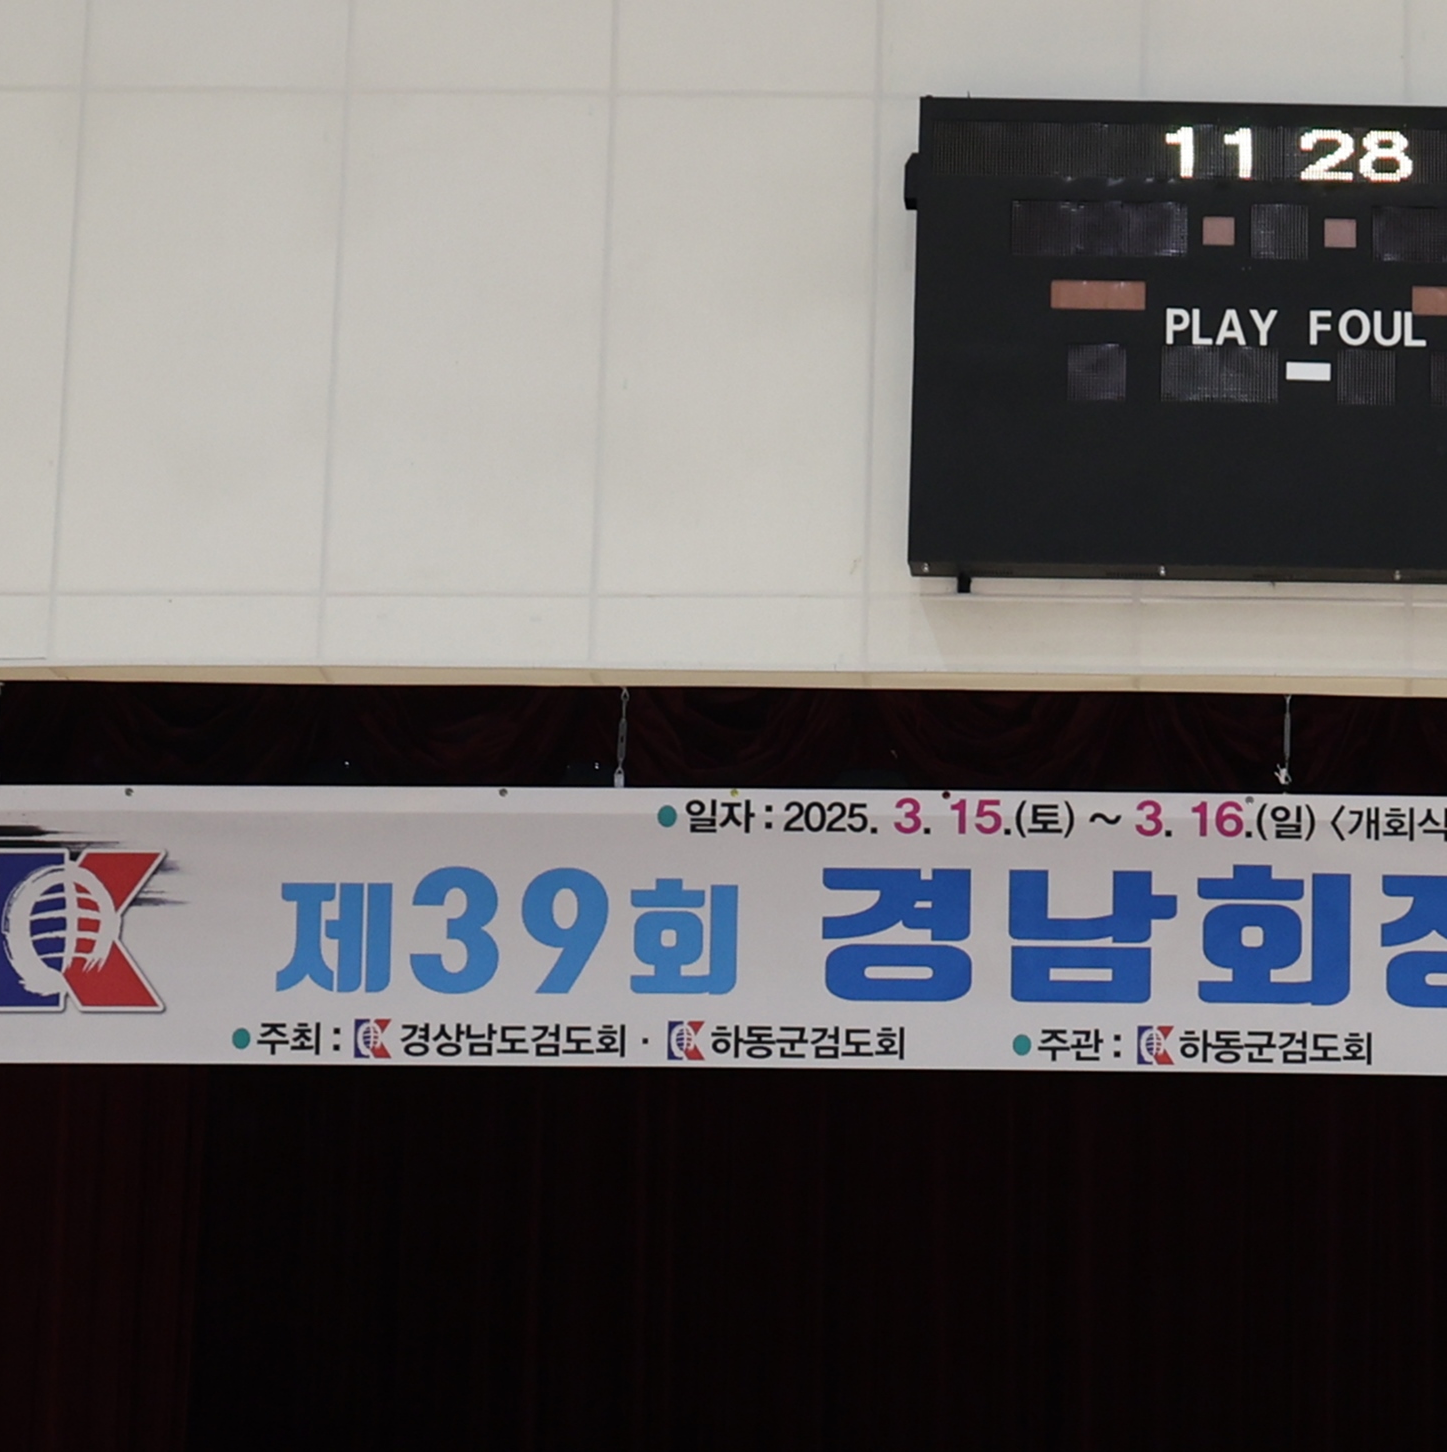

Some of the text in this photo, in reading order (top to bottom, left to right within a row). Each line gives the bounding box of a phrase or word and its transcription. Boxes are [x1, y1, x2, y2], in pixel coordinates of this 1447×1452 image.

[1164, 127, 1413, 181] 11 28
[1166, 308, 1426, 346] PLAY FOUL
[686, 799, 755, 834] 일자
[276, 867, 738, 995] 제39회
[257, 1022, 321, 1055] 주최
[401, 1023, 625, 1058] 경상남도검도회
[711, 1025, 904, 1060] 하동군검도회
[1038, 1029, 1104, 1061] 주관
[1179, 1030, 1372, 1065] 하동군검도회
